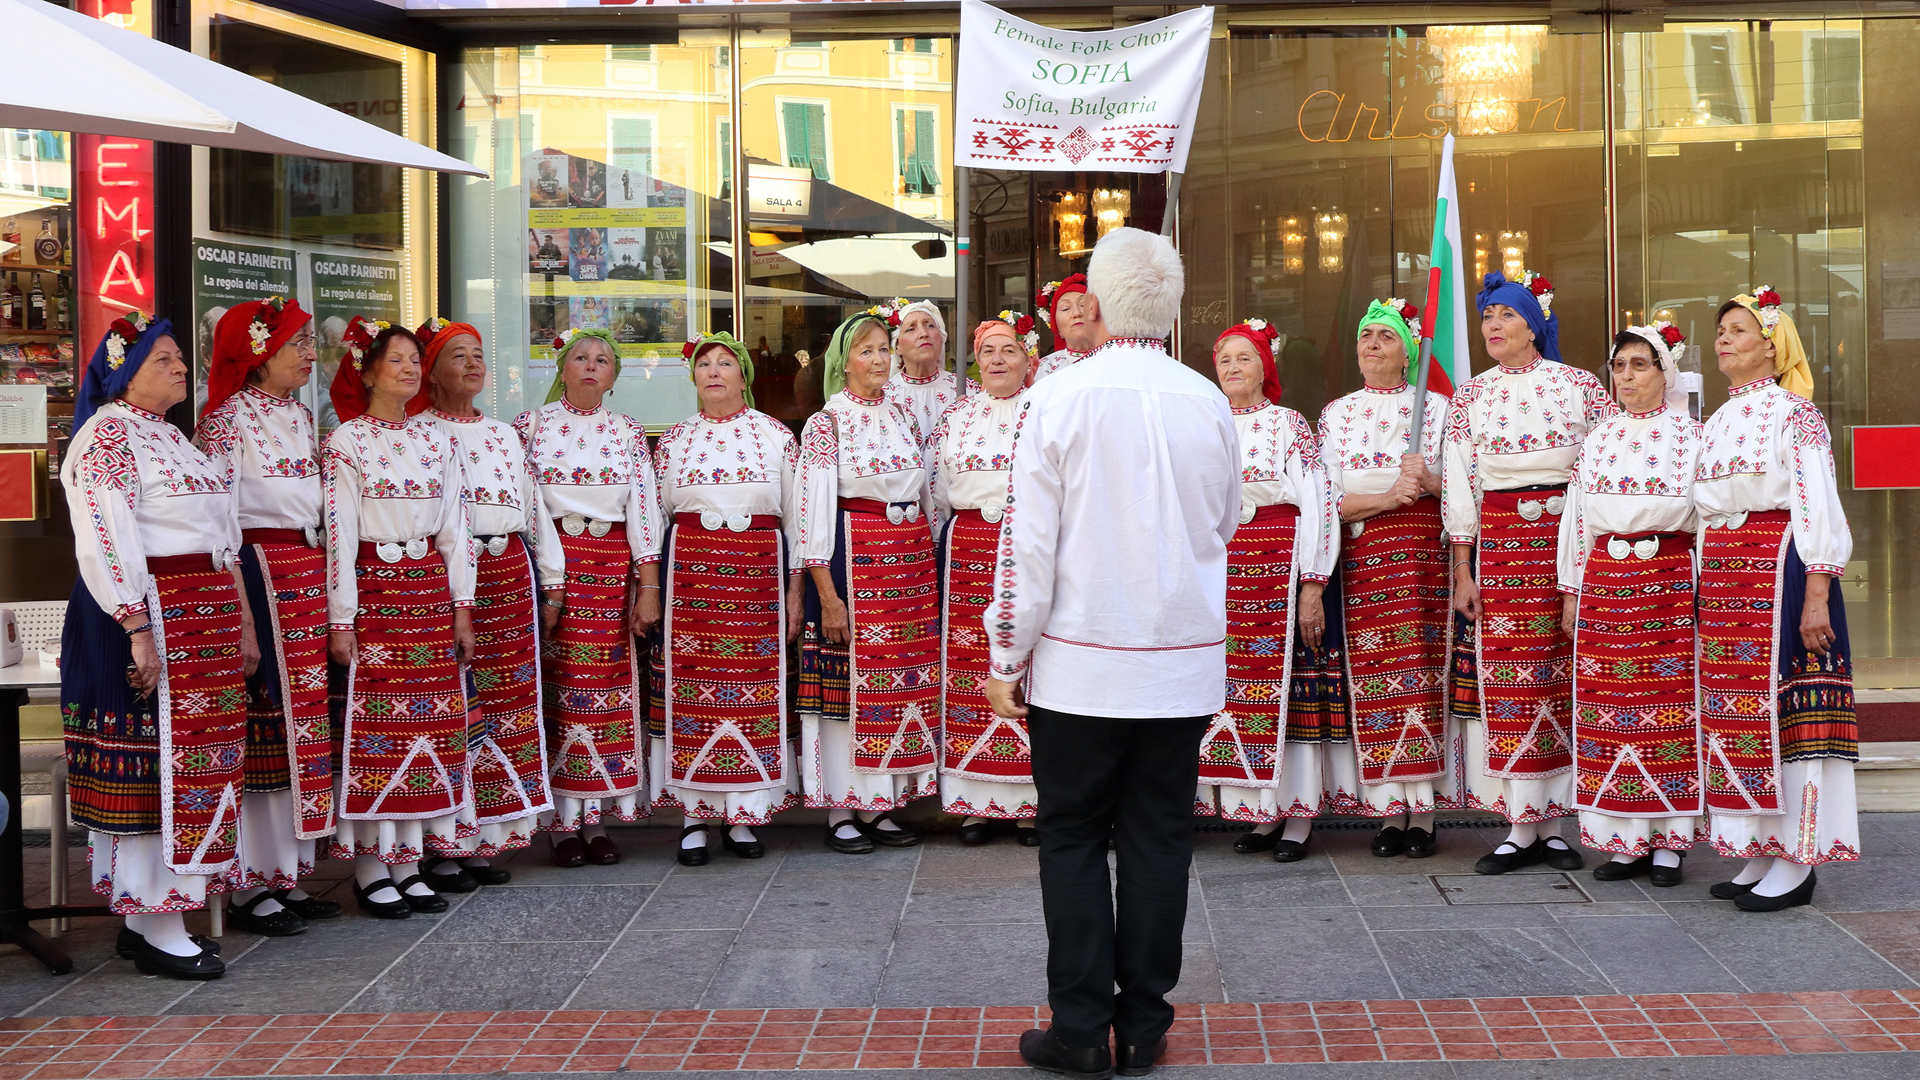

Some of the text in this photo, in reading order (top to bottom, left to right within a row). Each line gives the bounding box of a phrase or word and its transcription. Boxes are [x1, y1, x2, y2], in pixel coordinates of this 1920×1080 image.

[993, 18, 1179, 56] Female Folk Choir
[1032, 59, 1133, 85] SOFIA
[1002, 90, 1157, 121] Sofia, Bulgaria
[766, 197, 802, 207] SALA 4
[197, 246, 293, 271] OSCAR FARINETTI
[315, 261, 396, 280] OSCAR FARINETTI
[580, 264, 598, 273] SUPER
[204, 275, 289, 293] La regola del silenzio
[320, 287, 393, 301] La regola del silenzio
